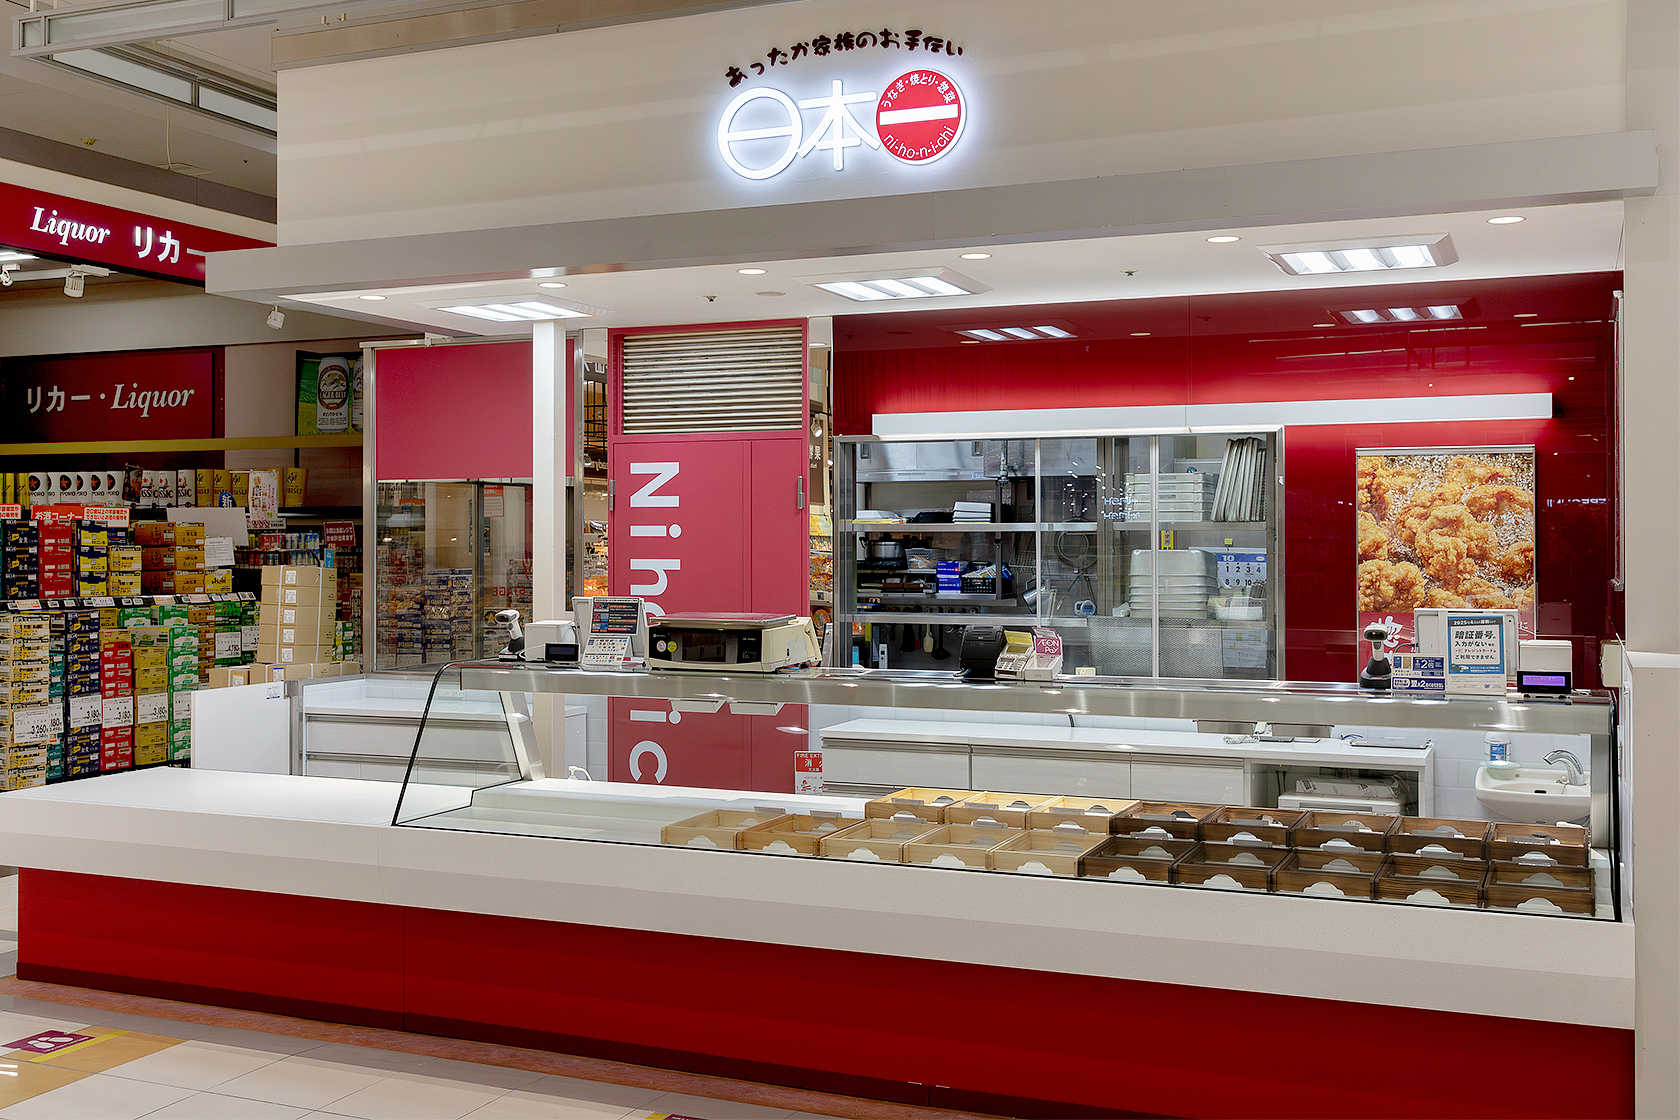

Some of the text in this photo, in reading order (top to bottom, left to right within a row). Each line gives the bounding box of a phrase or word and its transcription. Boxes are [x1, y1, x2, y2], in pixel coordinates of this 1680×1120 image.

[725, 28, 963, 88] あったか家族のお手伝い
[883, 125, 955, 160] ni-ho-n-i-chi
[30, 206, 111, 246] Liquor
